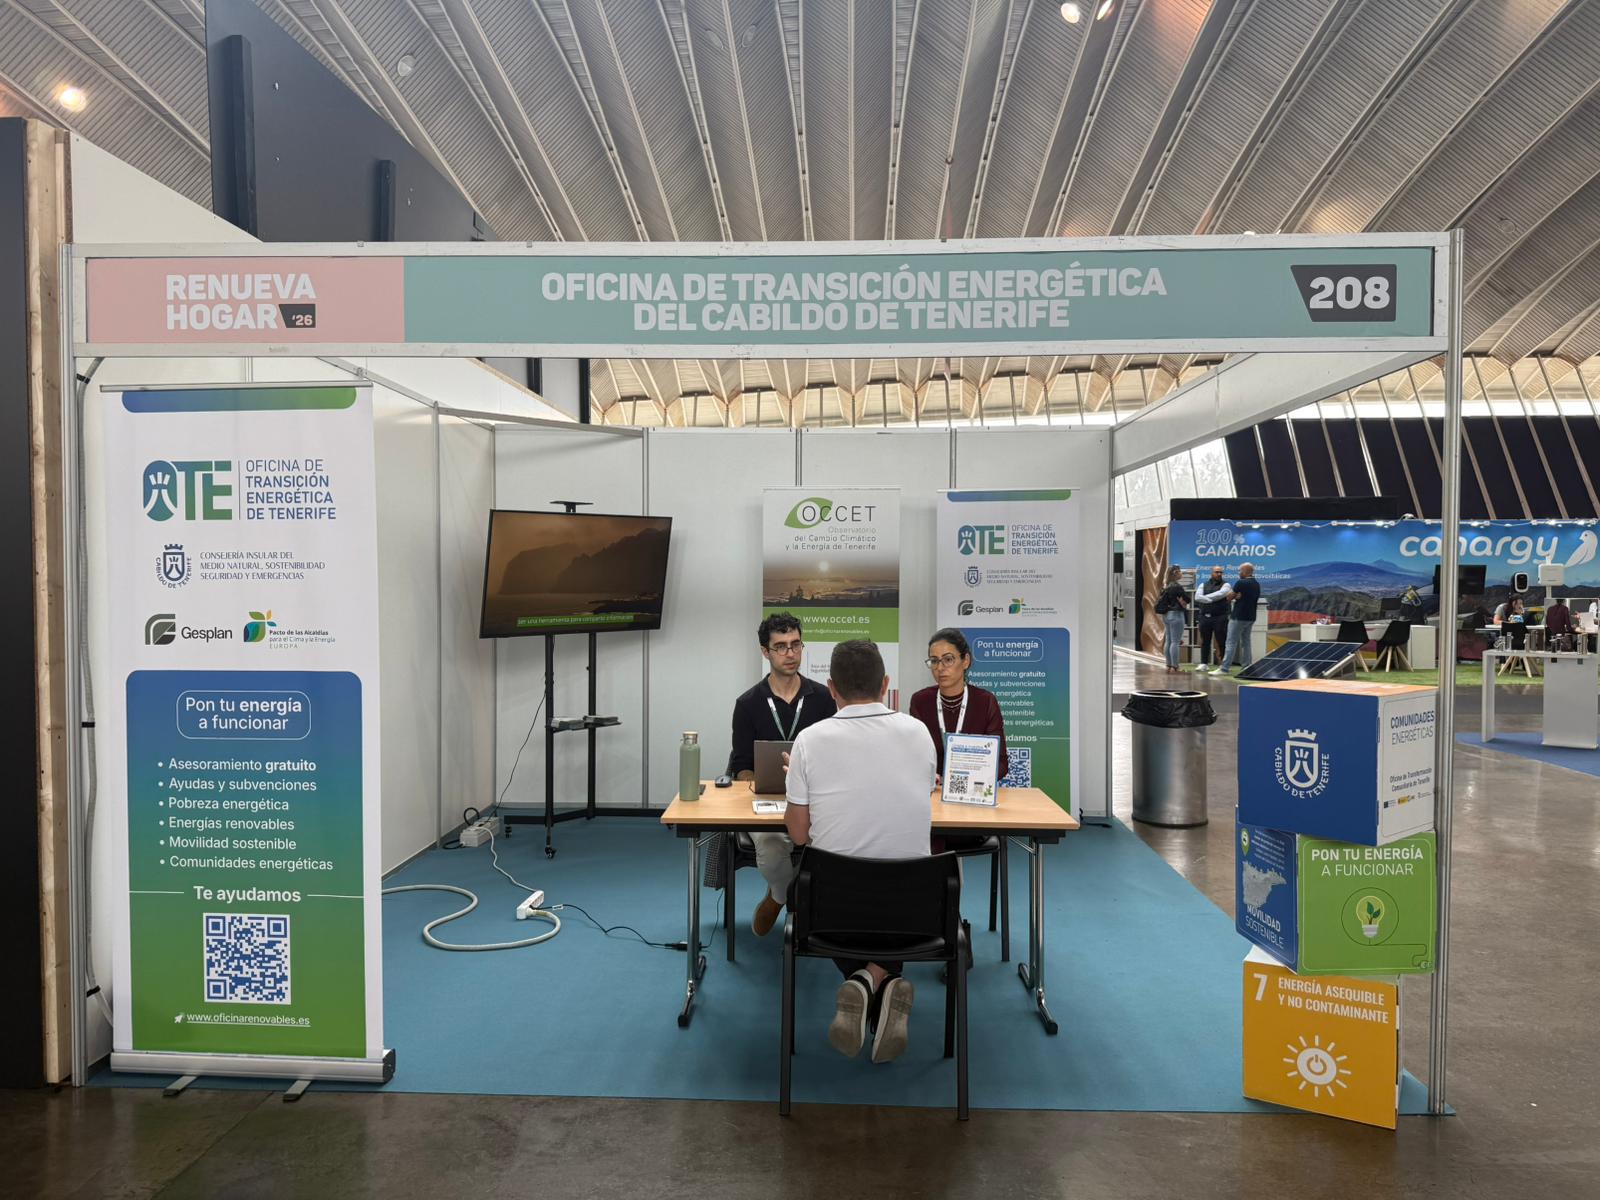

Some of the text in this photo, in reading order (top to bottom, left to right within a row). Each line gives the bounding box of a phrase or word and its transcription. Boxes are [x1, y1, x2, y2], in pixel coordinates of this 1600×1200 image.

[166, 274, 316, 300] RENUEVA
[542, 261, 1167, 301] OFICINA DE TRANSICIÓN ENERGÉTICA
[1310, 277, 1390, 309] 208
[167, 304, 278, 330] HOGAR
[634, 300, 1070, 331] DEL CABILDO DE TENERIFE
[246, 459, 323, 472] OFICINA DE
[246, 472, 329, 488] TRANSICIÓN
[247, 488, 333, 504] ENERGÉTICA
[247, 508, 336, 520] DE TENERIFE
[802, 506, 876, 522] OCCET
[828, 526, 876, 534] Observatorio
[1196, 528, 1245, 544] 100 %
[802, 543, 830, 551] Energía
[1012, 538, 1057, 546] ENERGÉTICA
[200, 551, 294, 560] CONSEJERÍA INSULAR DEL
[1196, 545, 1276, 556] CANARIOS
[200, 562, 224, 570] MEDIO
[266, 562, 326, 570] SOSTENIBILIDAD
[200, 572, 304, 580] SEGURIDAD Y EMERGENCIAS
[976, 606, 1004, 614] Gesplan
[803, 616, 870, 624] www.occet.es
[181, 626, 233, 642] Gesplan
[992, 649, 1032, 657] funcionar
[1006, 641, 1039, 650] energía
[186, 697, 302, 716] Pon tu energía
[198, 715, 288, 730] a funcionar
[1015, 719, 1054, 727] energéticas
[1391, 710, 1434, 729] COMUNIDADES
[1392, 725, 1433, 745] ENERGÉTICAS
[169, 758, 316, 773] Asesoramiento gratuito
[1275, 747, 1330, 798] CABILDO DE TENERIFE
[169, 778, 317, 792] Ayudas y subvenciones
[169, 797, 289, 812] Pobreza energética
[169, 817, 295, 831] Energías renovables
[170, 836, 296, 849] Movilidad sostenible
[1312, 845, 1423, 861] PON TU ENERGÍA
[170, 856, 333, 872] Comunidades energéticas
[1322, 864, 1413, 876] A FUNCIONAR
[194, 886, 301, 904] Te ayudamos
[1247, 904, 1280, 932] MOVILIDAD
[1245, 916, 1284, 949] SOSTENIBLE
[1254, 973, 1267, 1000] 7
[1278, 977, 1384, 1006] ENERGÍA ASEQUIBLE
[1278, 994, 1389, 1024] Y NO CONTAMINANTE
[187, 1012, 310, 1026] www.oficinarenovables.es
